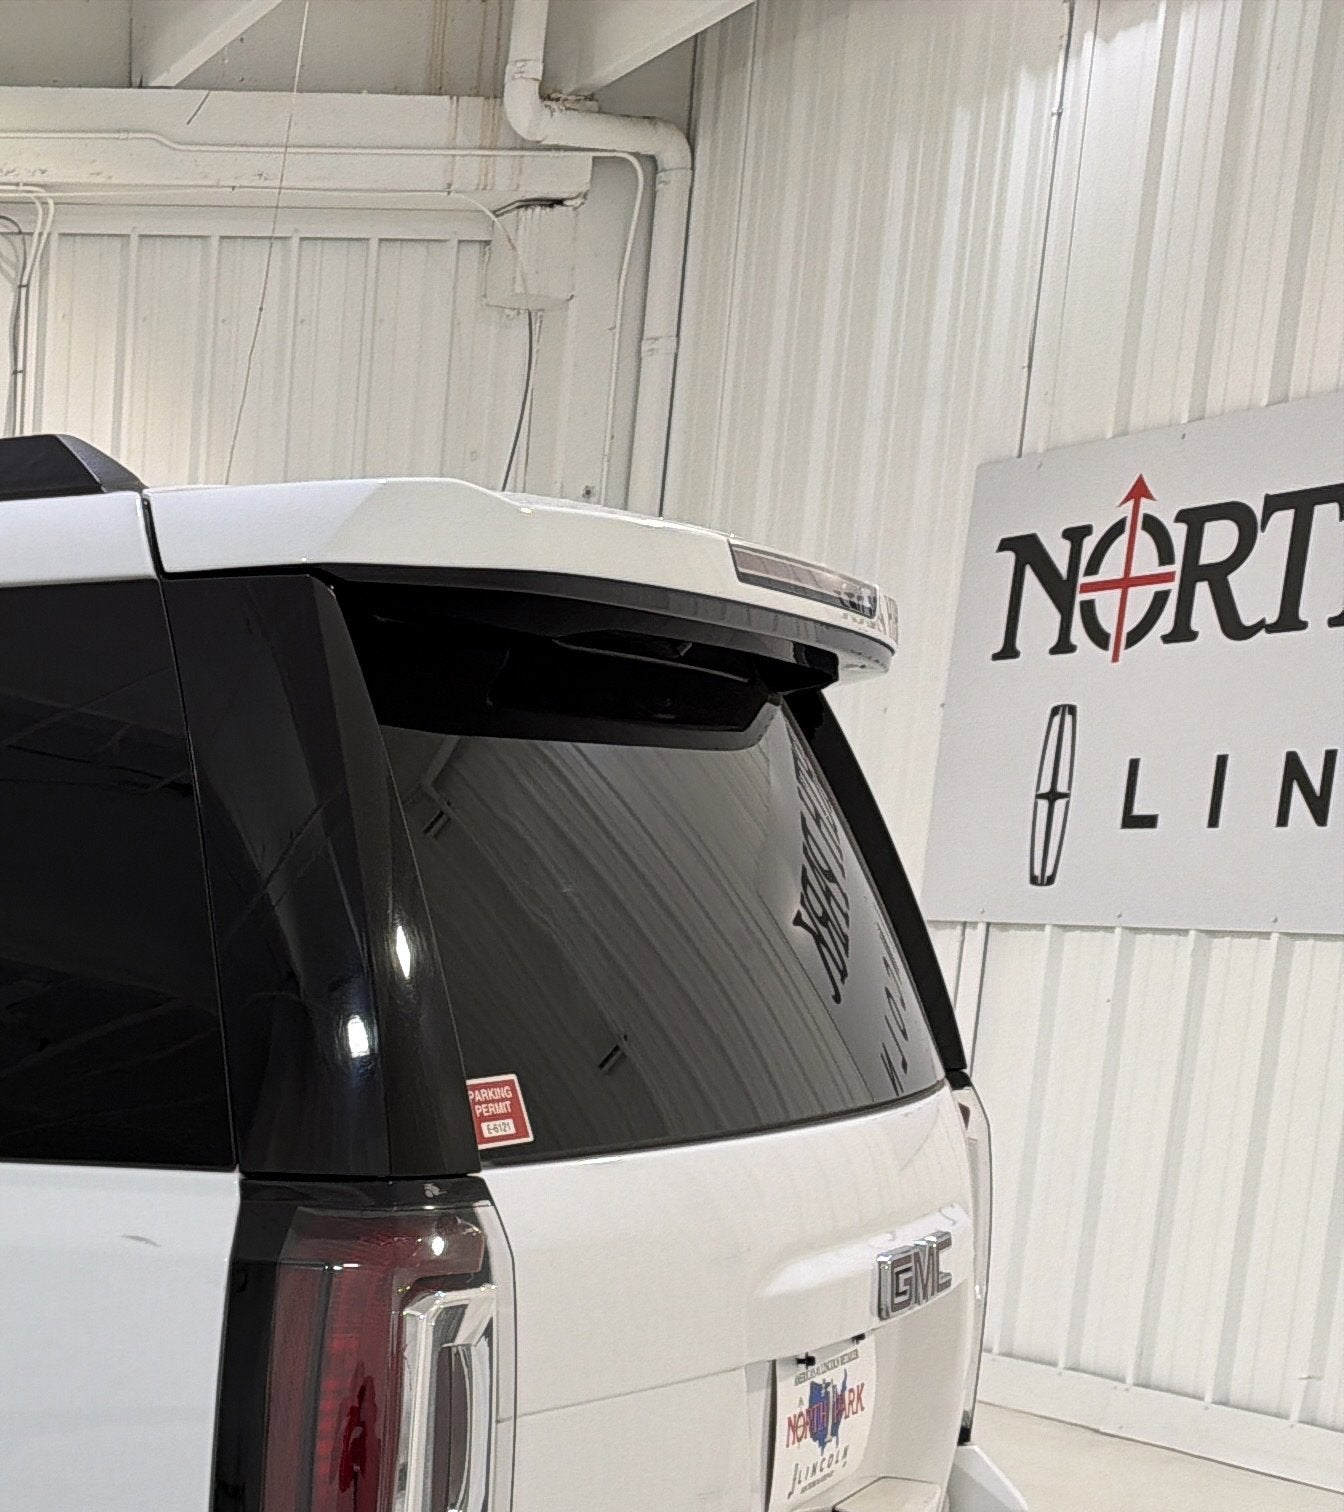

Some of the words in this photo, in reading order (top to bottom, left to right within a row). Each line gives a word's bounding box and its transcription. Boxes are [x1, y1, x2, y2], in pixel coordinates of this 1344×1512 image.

[990, 483, 1344, 661] NORT
[467, 1085, 513, 1102] PARKING
[475, 1100, 512, 1117] PERMIT
[876, 1231, 953, 1321] GMC
